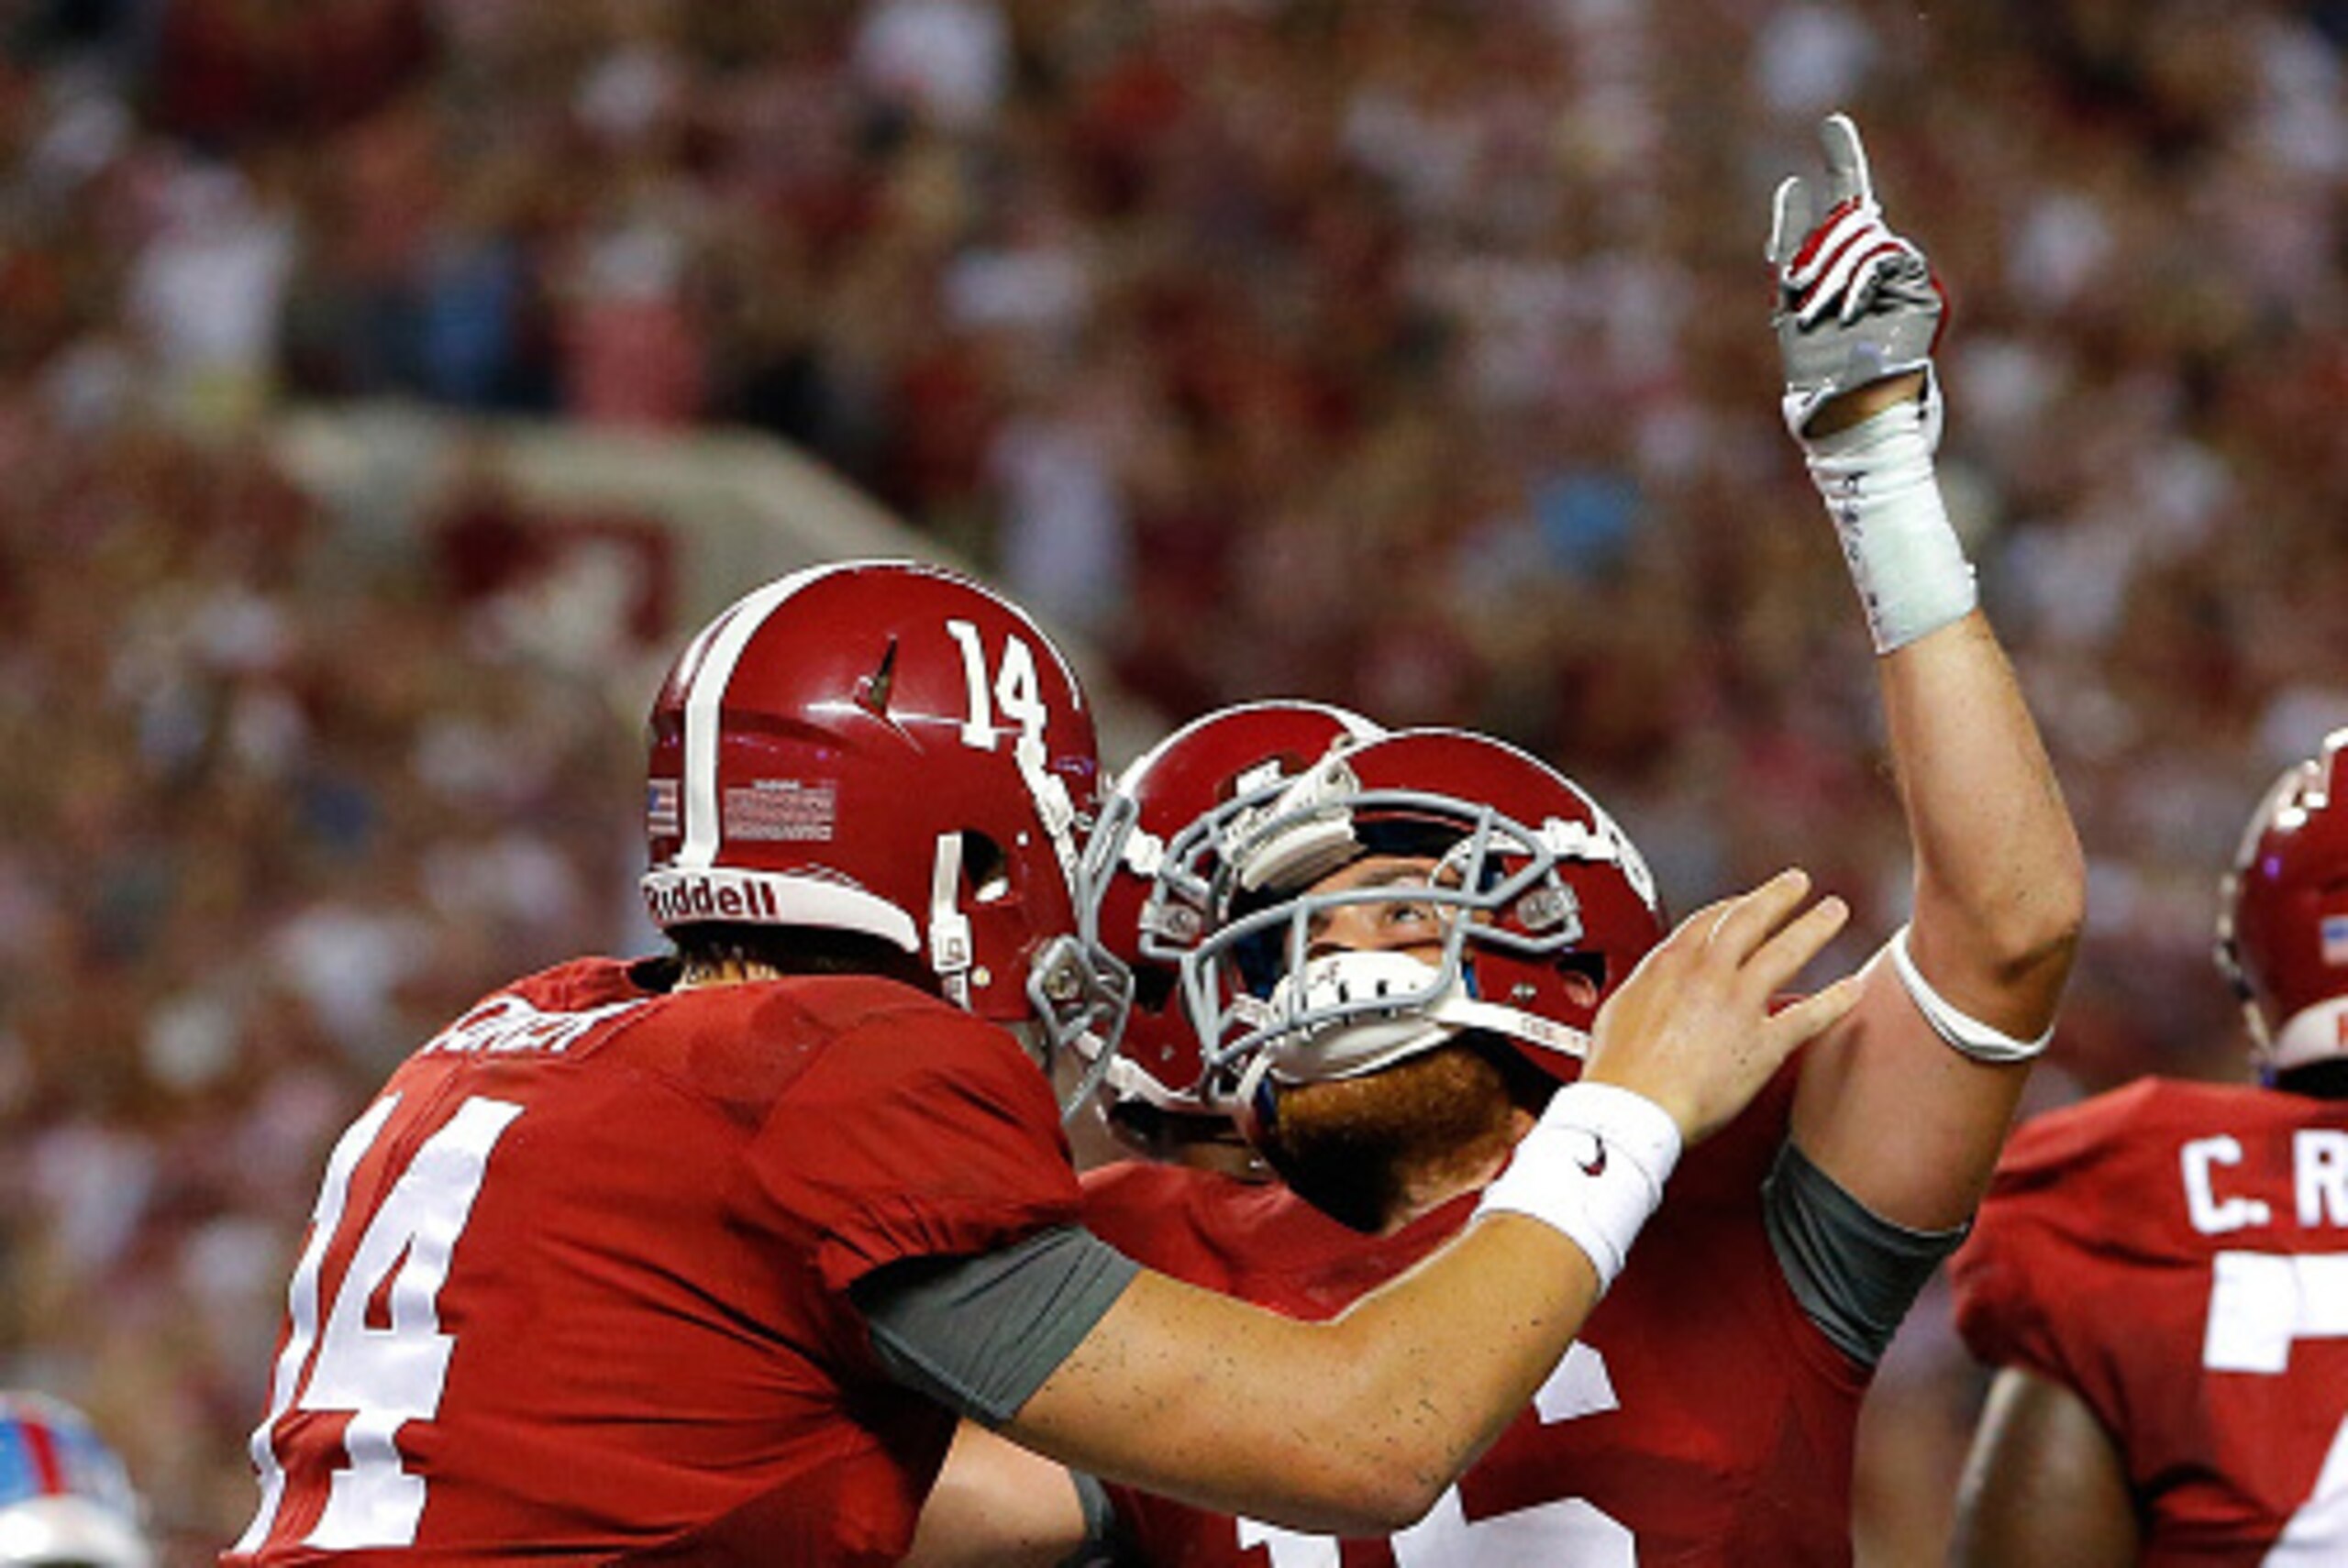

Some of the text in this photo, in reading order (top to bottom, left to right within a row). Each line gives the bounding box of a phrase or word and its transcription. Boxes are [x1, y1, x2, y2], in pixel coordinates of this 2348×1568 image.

[946, 619, 1047, 763] 14
[643, 877, 777, 919] Riddell
[2180, 1133, 2271, 1234] C.
[231, 1090, 525, 1554] 14
